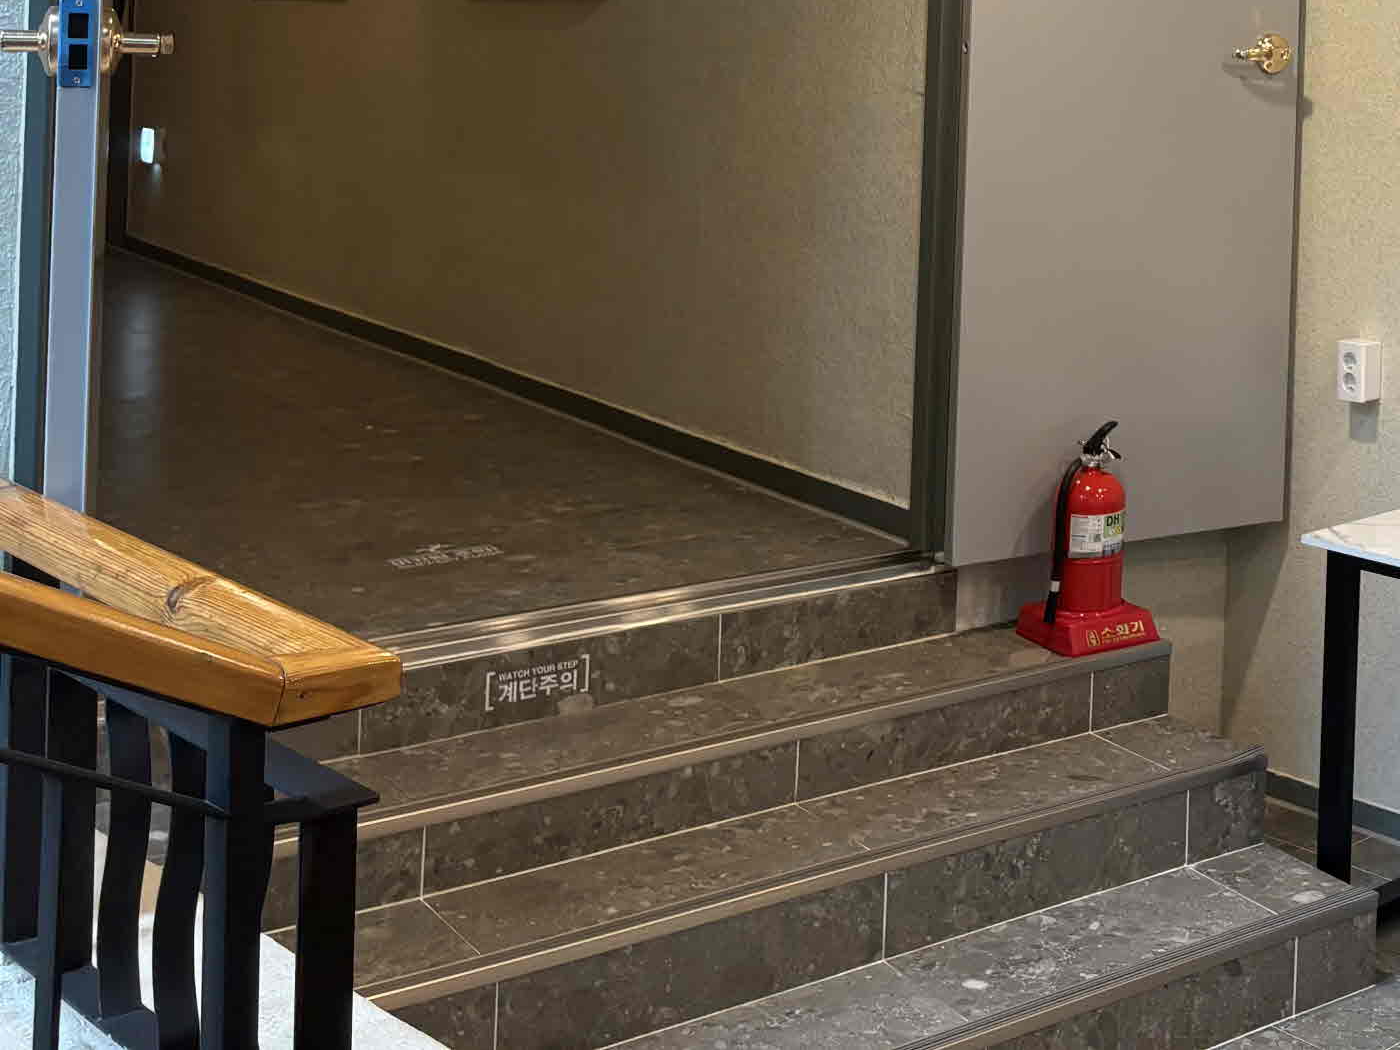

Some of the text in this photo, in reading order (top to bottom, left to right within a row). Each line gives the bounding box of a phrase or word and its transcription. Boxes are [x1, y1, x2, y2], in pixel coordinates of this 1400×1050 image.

[1100, 620, 1145, 638] 소화기
[499, 659, 579, 682] WATCH YOUR STEP
